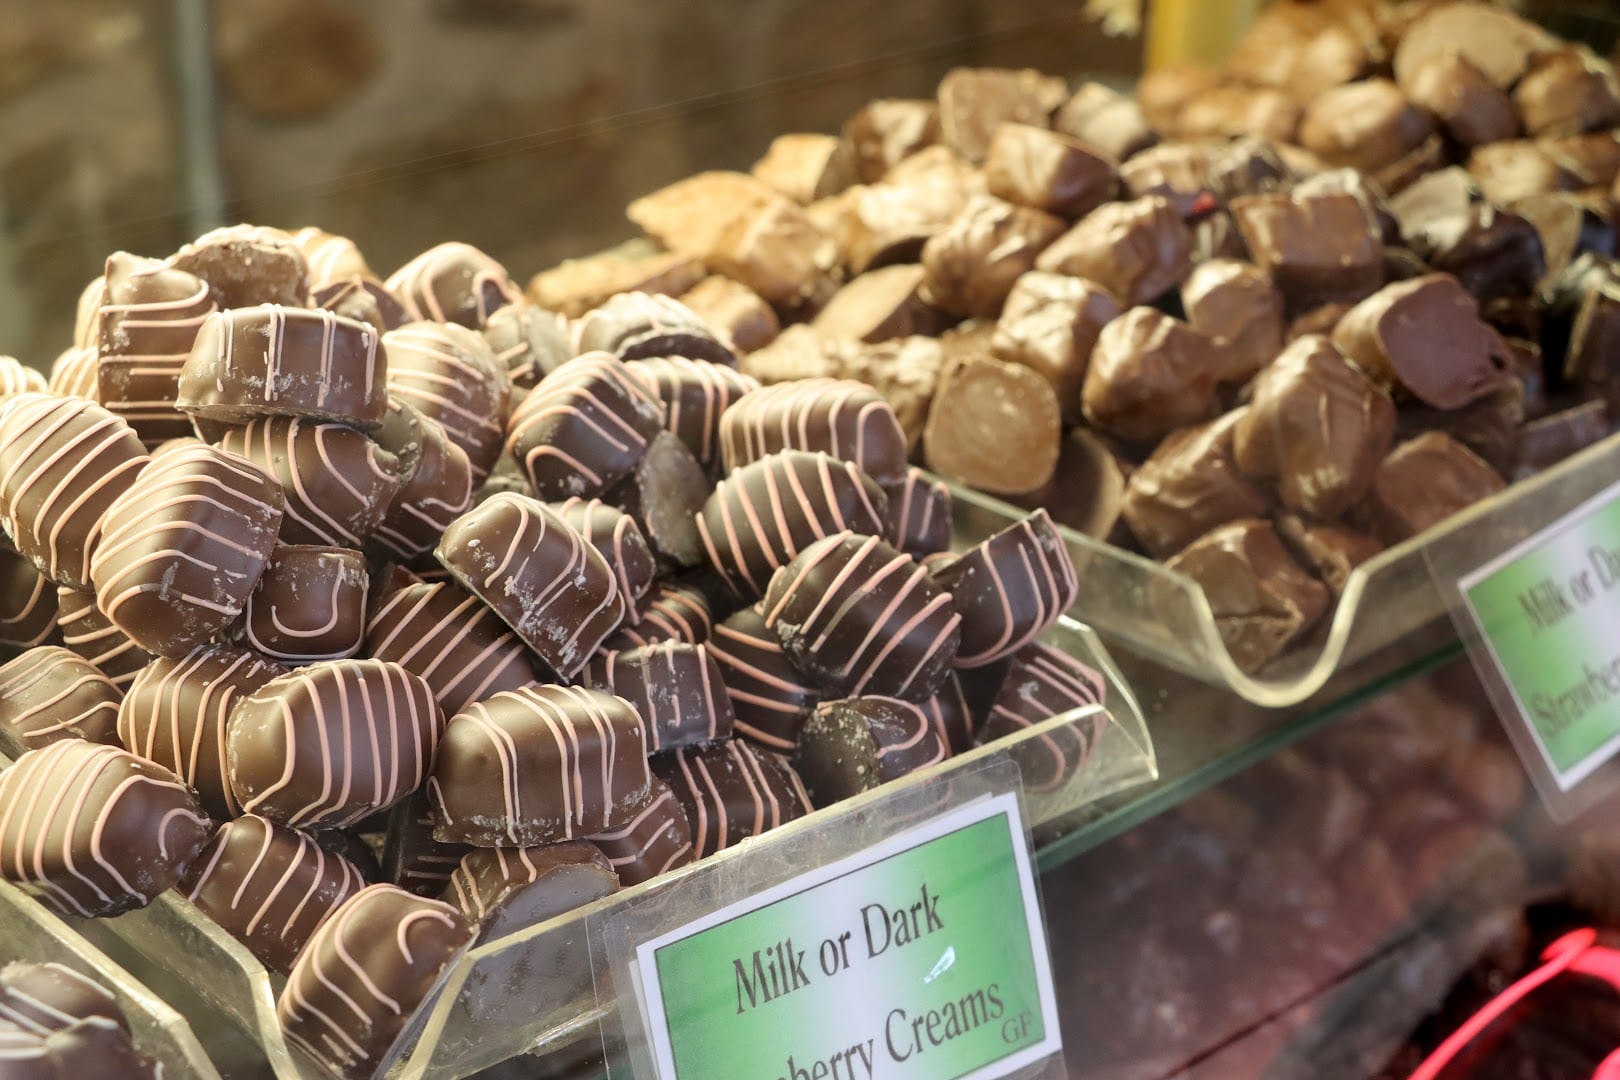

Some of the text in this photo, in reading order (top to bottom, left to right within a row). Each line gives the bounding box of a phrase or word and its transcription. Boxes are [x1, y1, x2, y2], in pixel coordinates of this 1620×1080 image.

[733, 883, 944, 1014] Milk or Dark
[885, 984, 1004, 1062] Creams
[1002, 1011, 1032, 1045] GF
